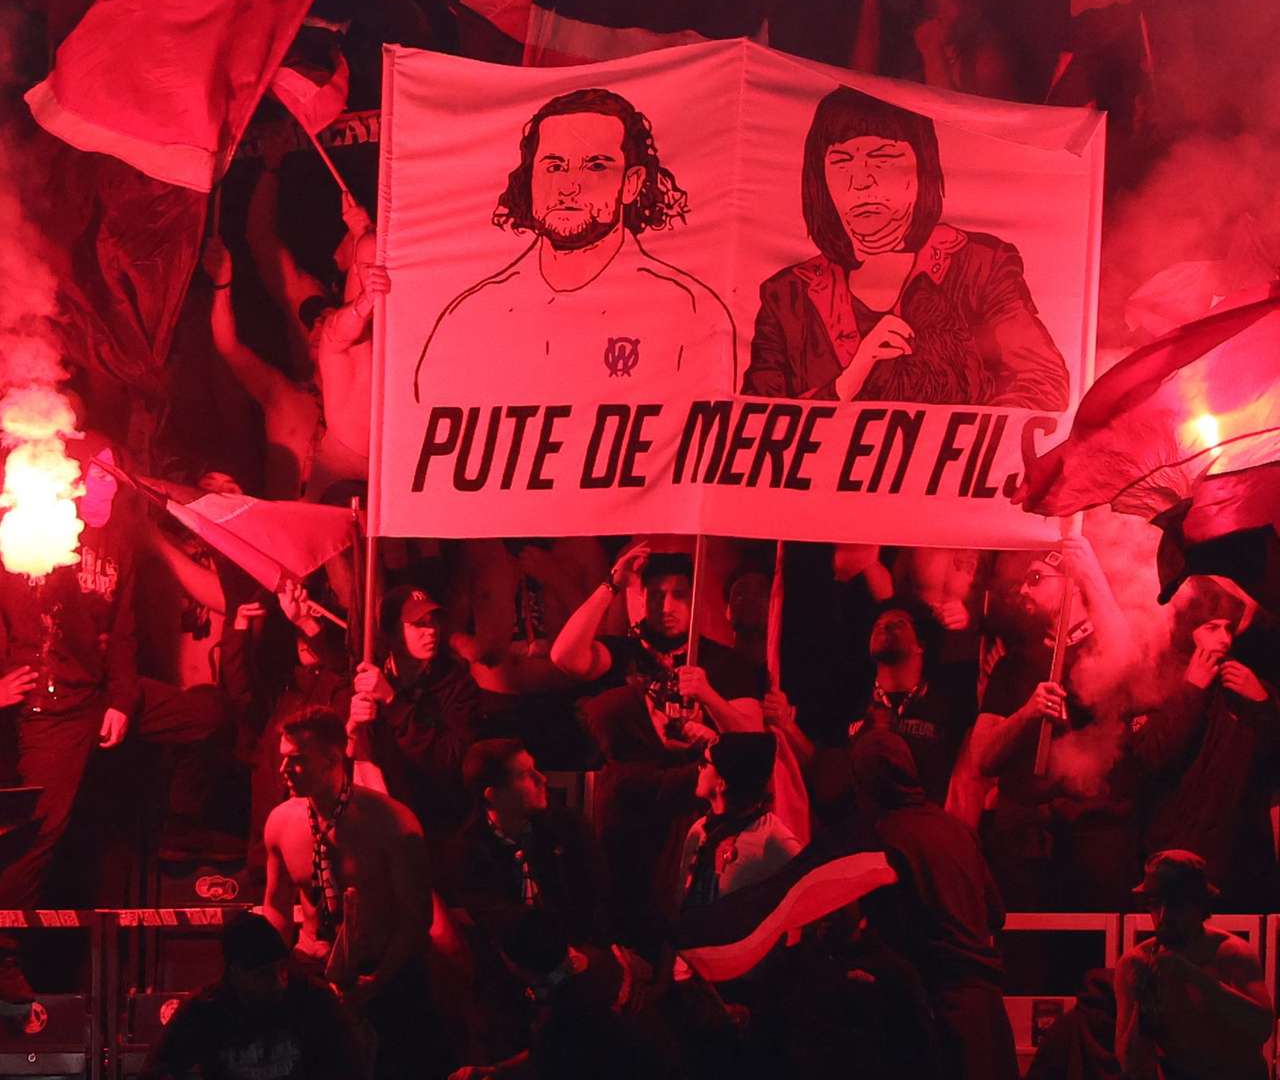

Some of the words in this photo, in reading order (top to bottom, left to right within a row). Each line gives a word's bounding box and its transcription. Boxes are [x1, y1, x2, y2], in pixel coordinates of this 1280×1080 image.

[412, 405, 572, 492] PUTE
[580, 404, 663, 488] DE
[672, 401, 830, 490] MERE
[837, 409, 925, 494] EN
